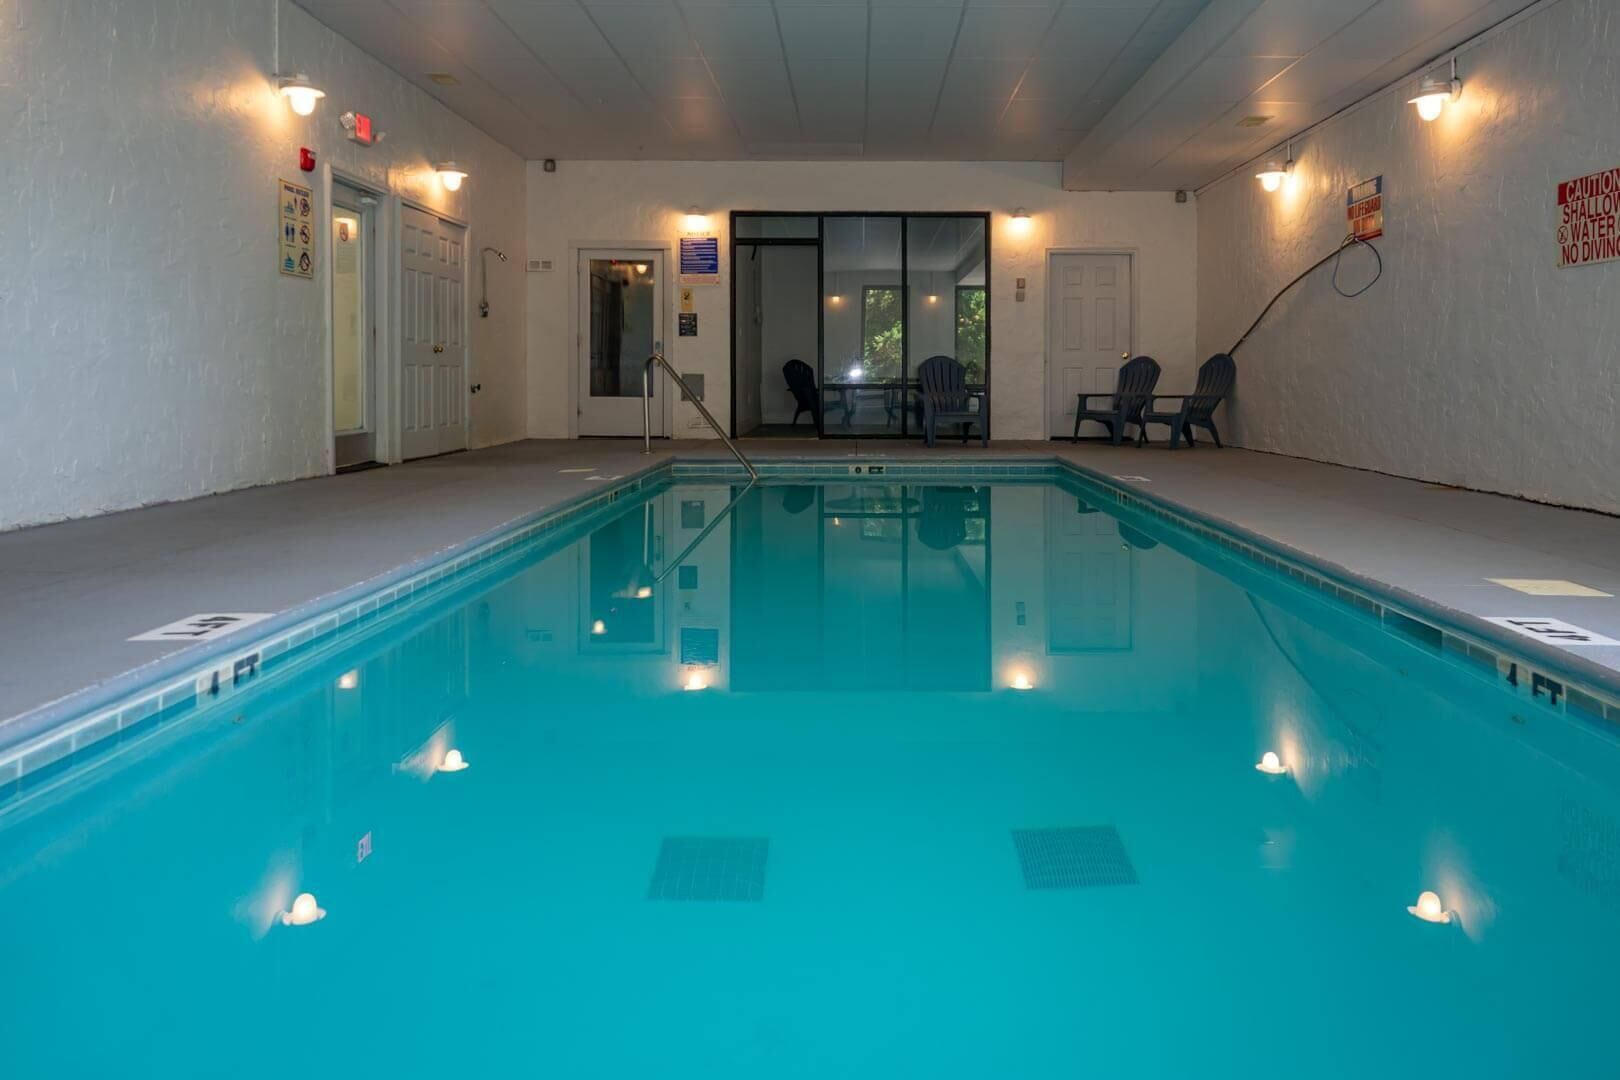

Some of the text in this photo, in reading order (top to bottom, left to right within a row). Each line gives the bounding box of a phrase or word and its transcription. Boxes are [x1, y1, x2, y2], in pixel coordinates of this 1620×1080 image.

[1566, 168, 1620, 203] CAUTION
[1571, 215, 1616, 242] WATER
[1562, 243, 1579, 265] NO
[1532, 671, 1563, 705] FT
